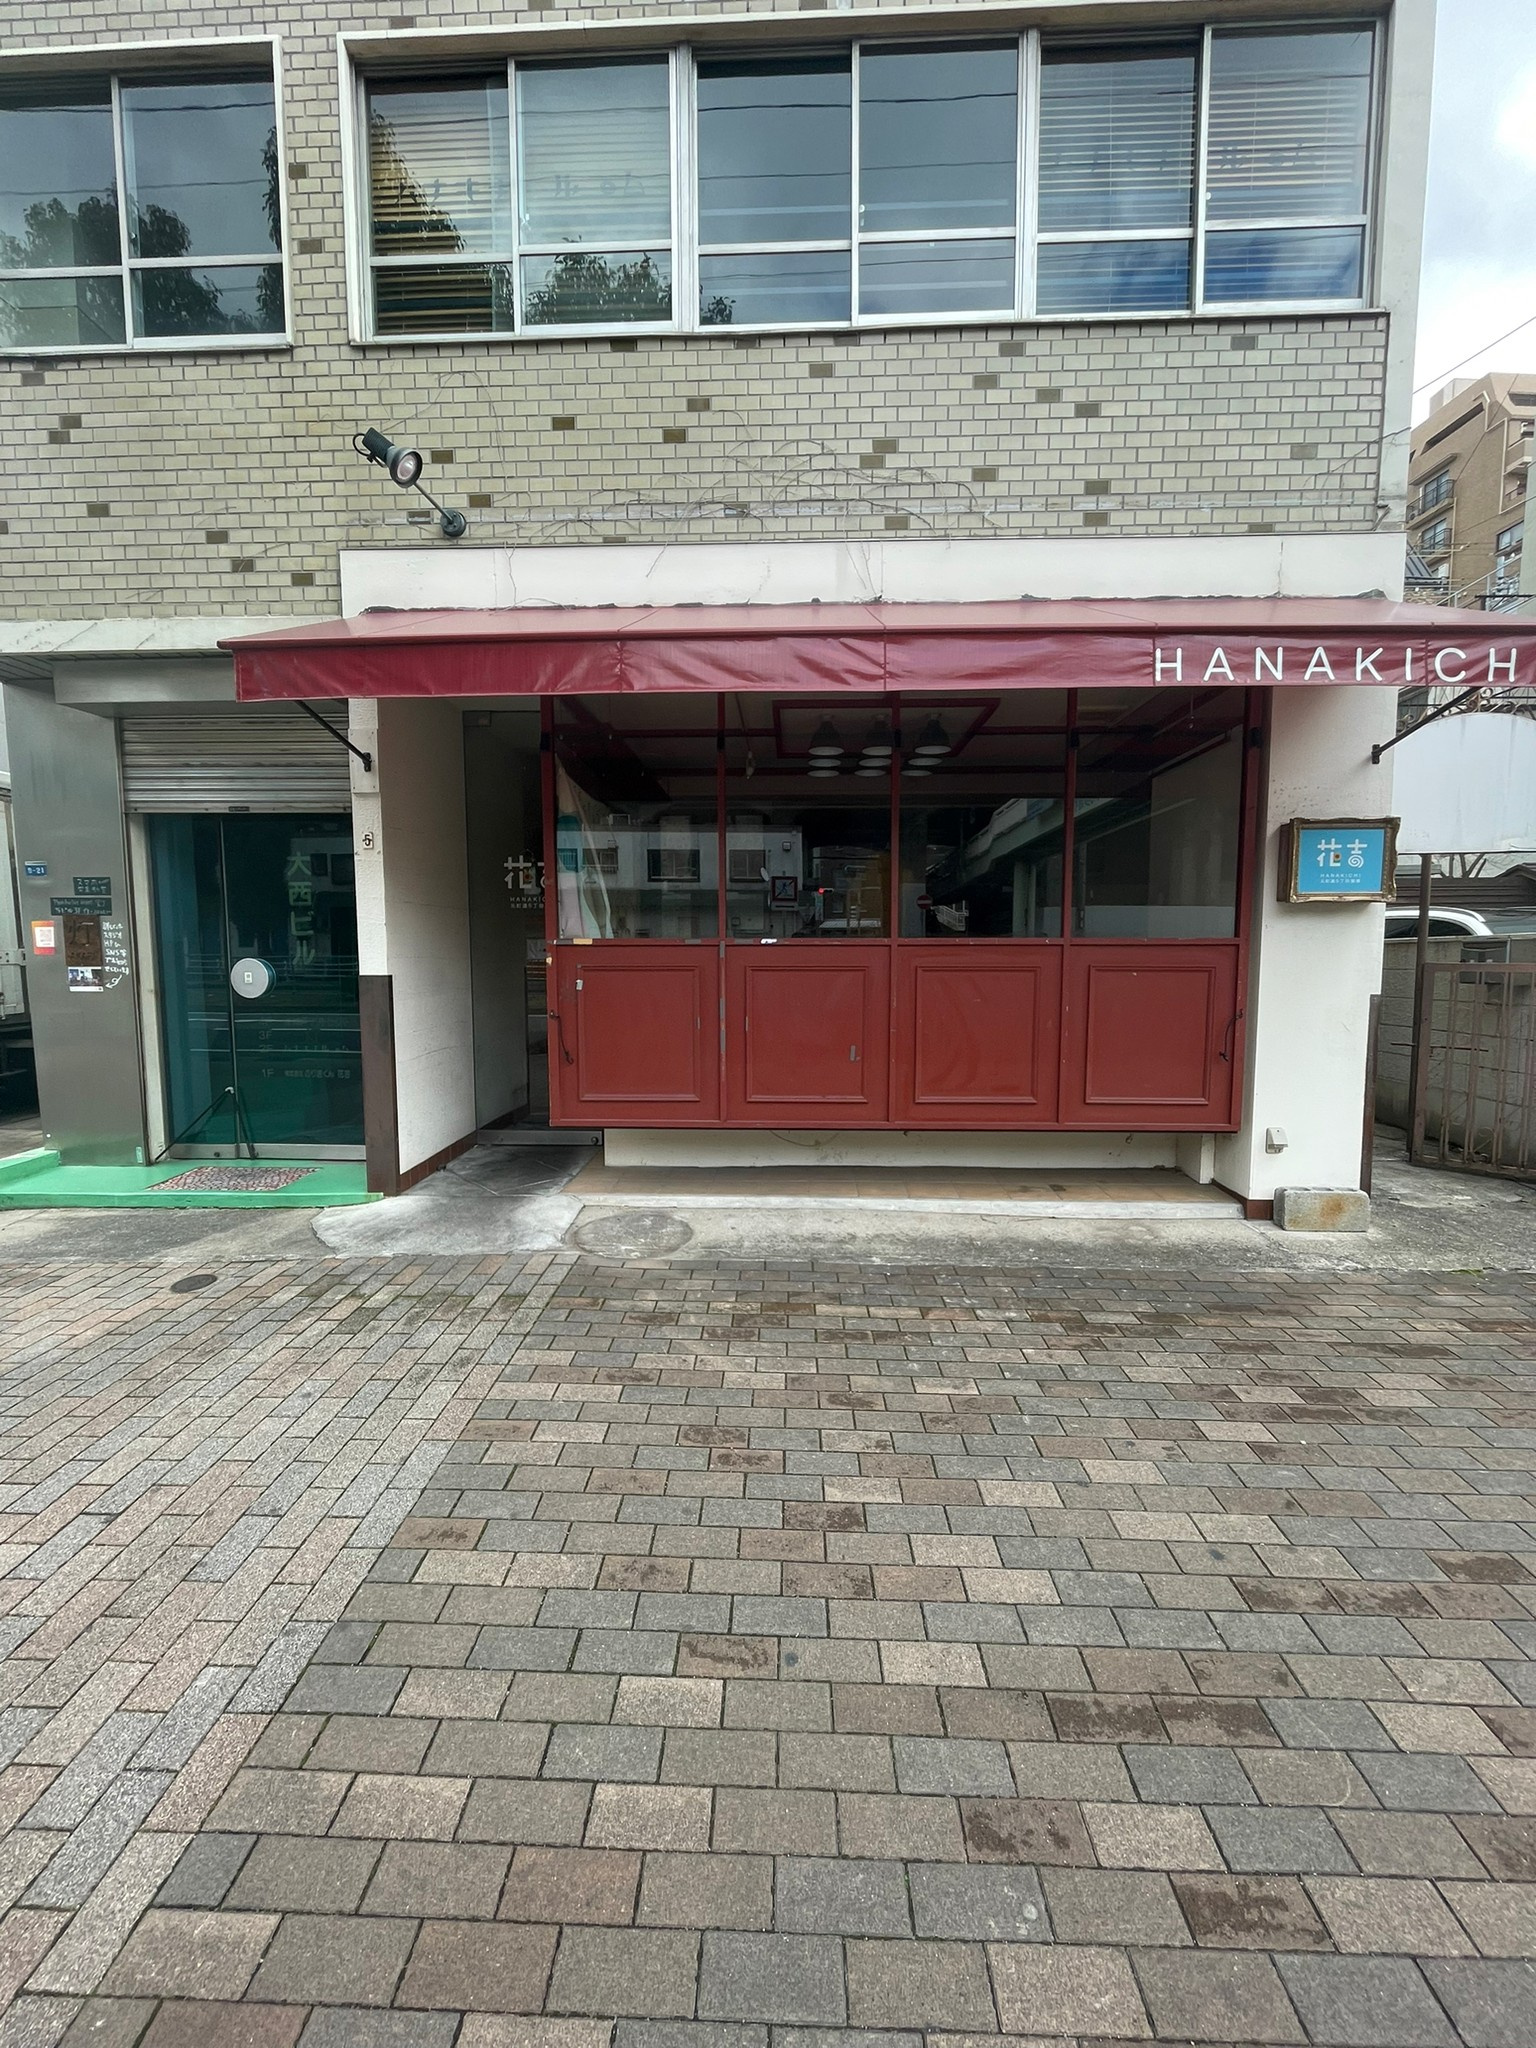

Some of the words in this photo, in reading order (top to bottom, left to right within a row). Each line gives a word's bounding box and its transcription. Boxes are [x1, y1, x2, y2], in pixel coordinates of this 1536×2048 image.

[1154, 646, 1517, 682] HANAKICH
[1317, 838, 1368, 868] 花吉
[287, 852, 315, 966] 大西ビル
